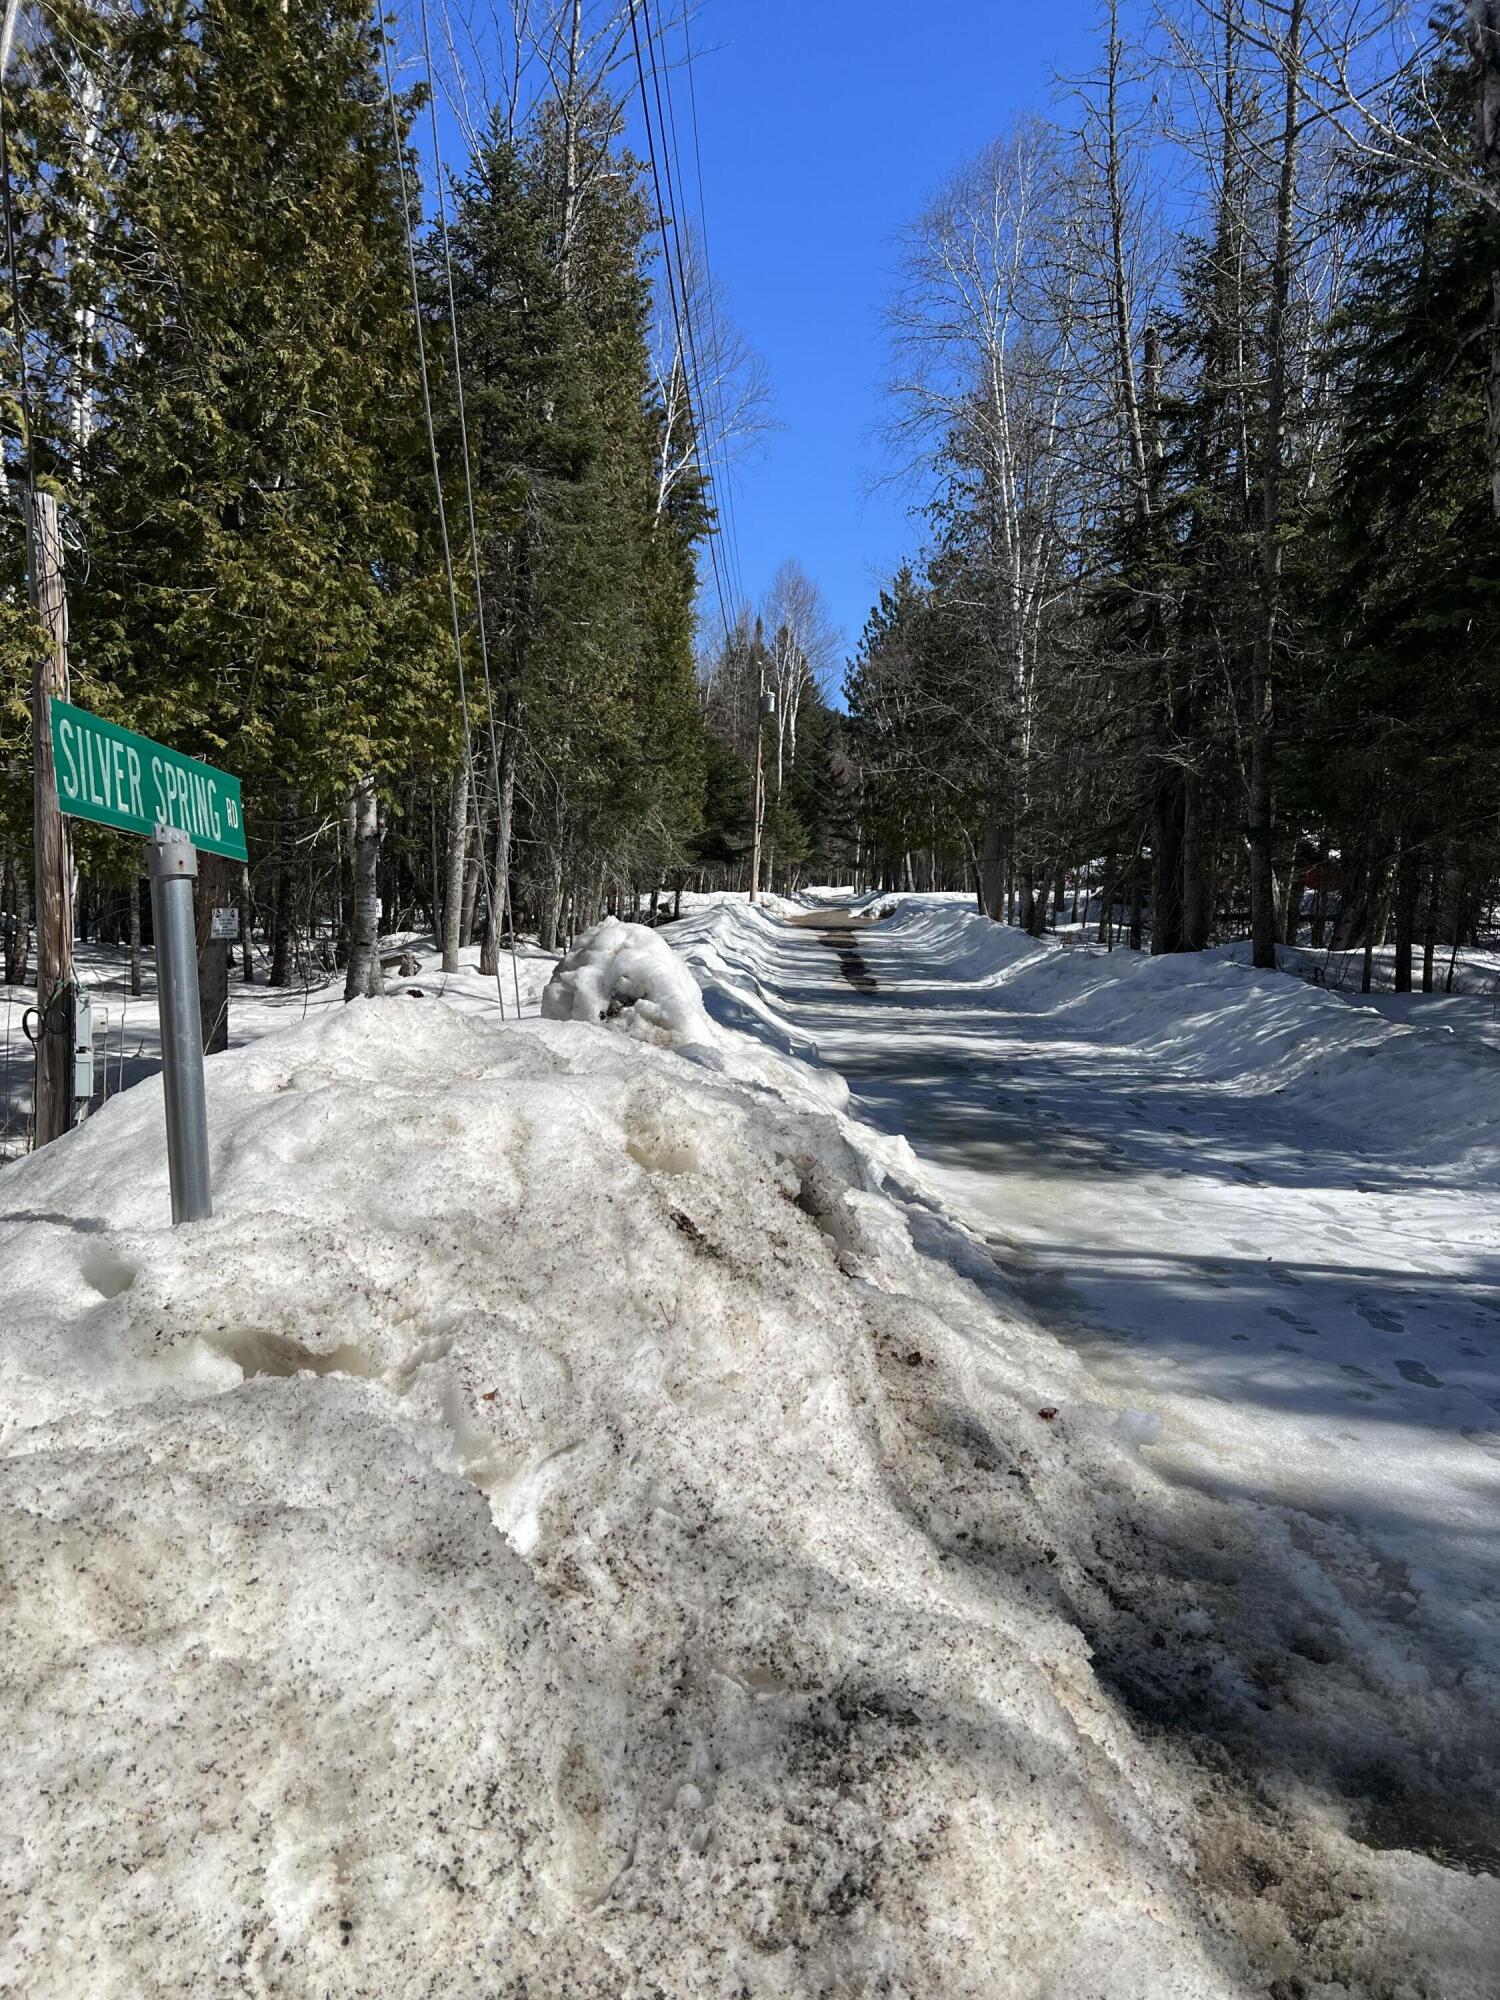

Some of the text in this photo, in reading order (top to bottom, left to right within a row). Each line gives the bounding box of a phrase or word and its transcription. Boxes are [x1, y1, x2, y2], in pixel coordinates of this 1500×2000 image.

[60, 719, 239, 841] SILVER SPRING RD
